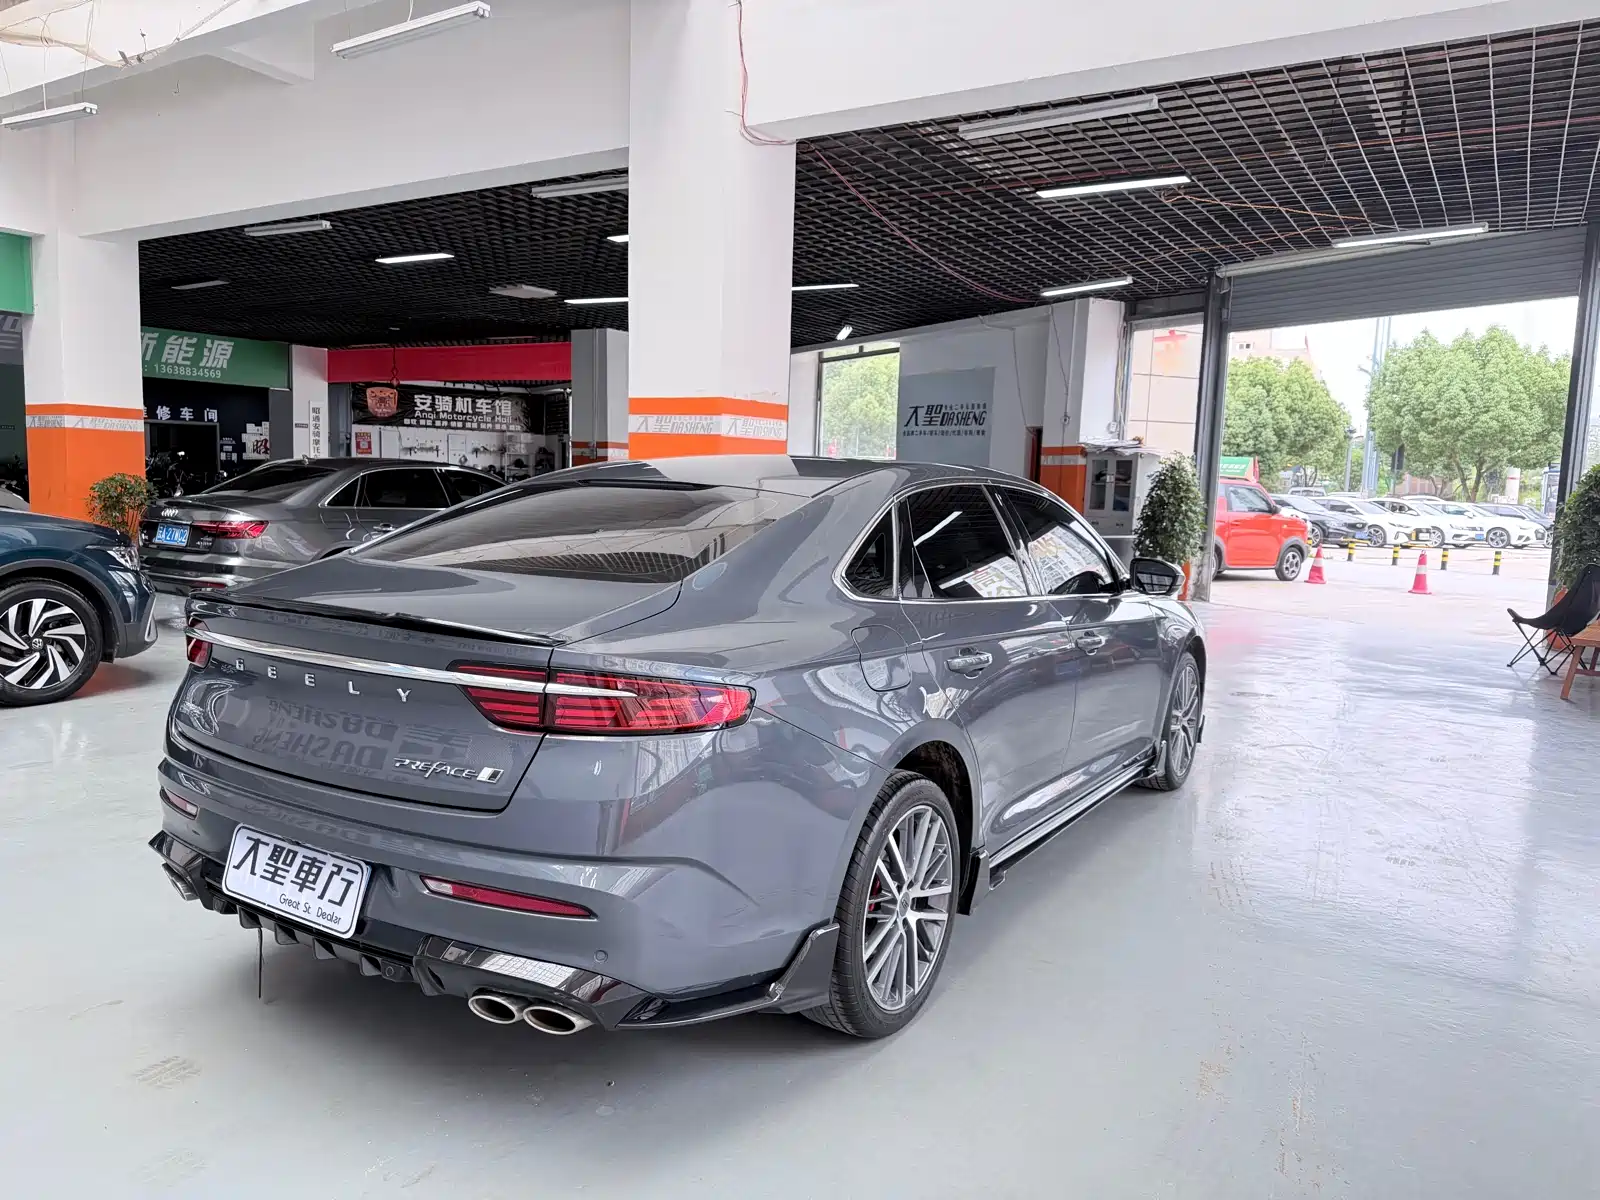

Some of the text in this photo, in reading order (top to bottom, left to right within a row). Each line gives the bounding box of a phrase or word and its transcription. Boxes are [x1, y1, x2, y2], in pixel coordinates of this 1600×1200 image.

[414, 394, 512, 416] 安骑机车馆
[414, 411, 436, 419] Anqi
[440, 412, 492, 423] Motorcycle
[940, 411, 987, 427] DASHENG
[235, 658, 412, 703] GEELY
[279, 893, 300, 910] Great
[316, 906, 342, 925] Dealer
